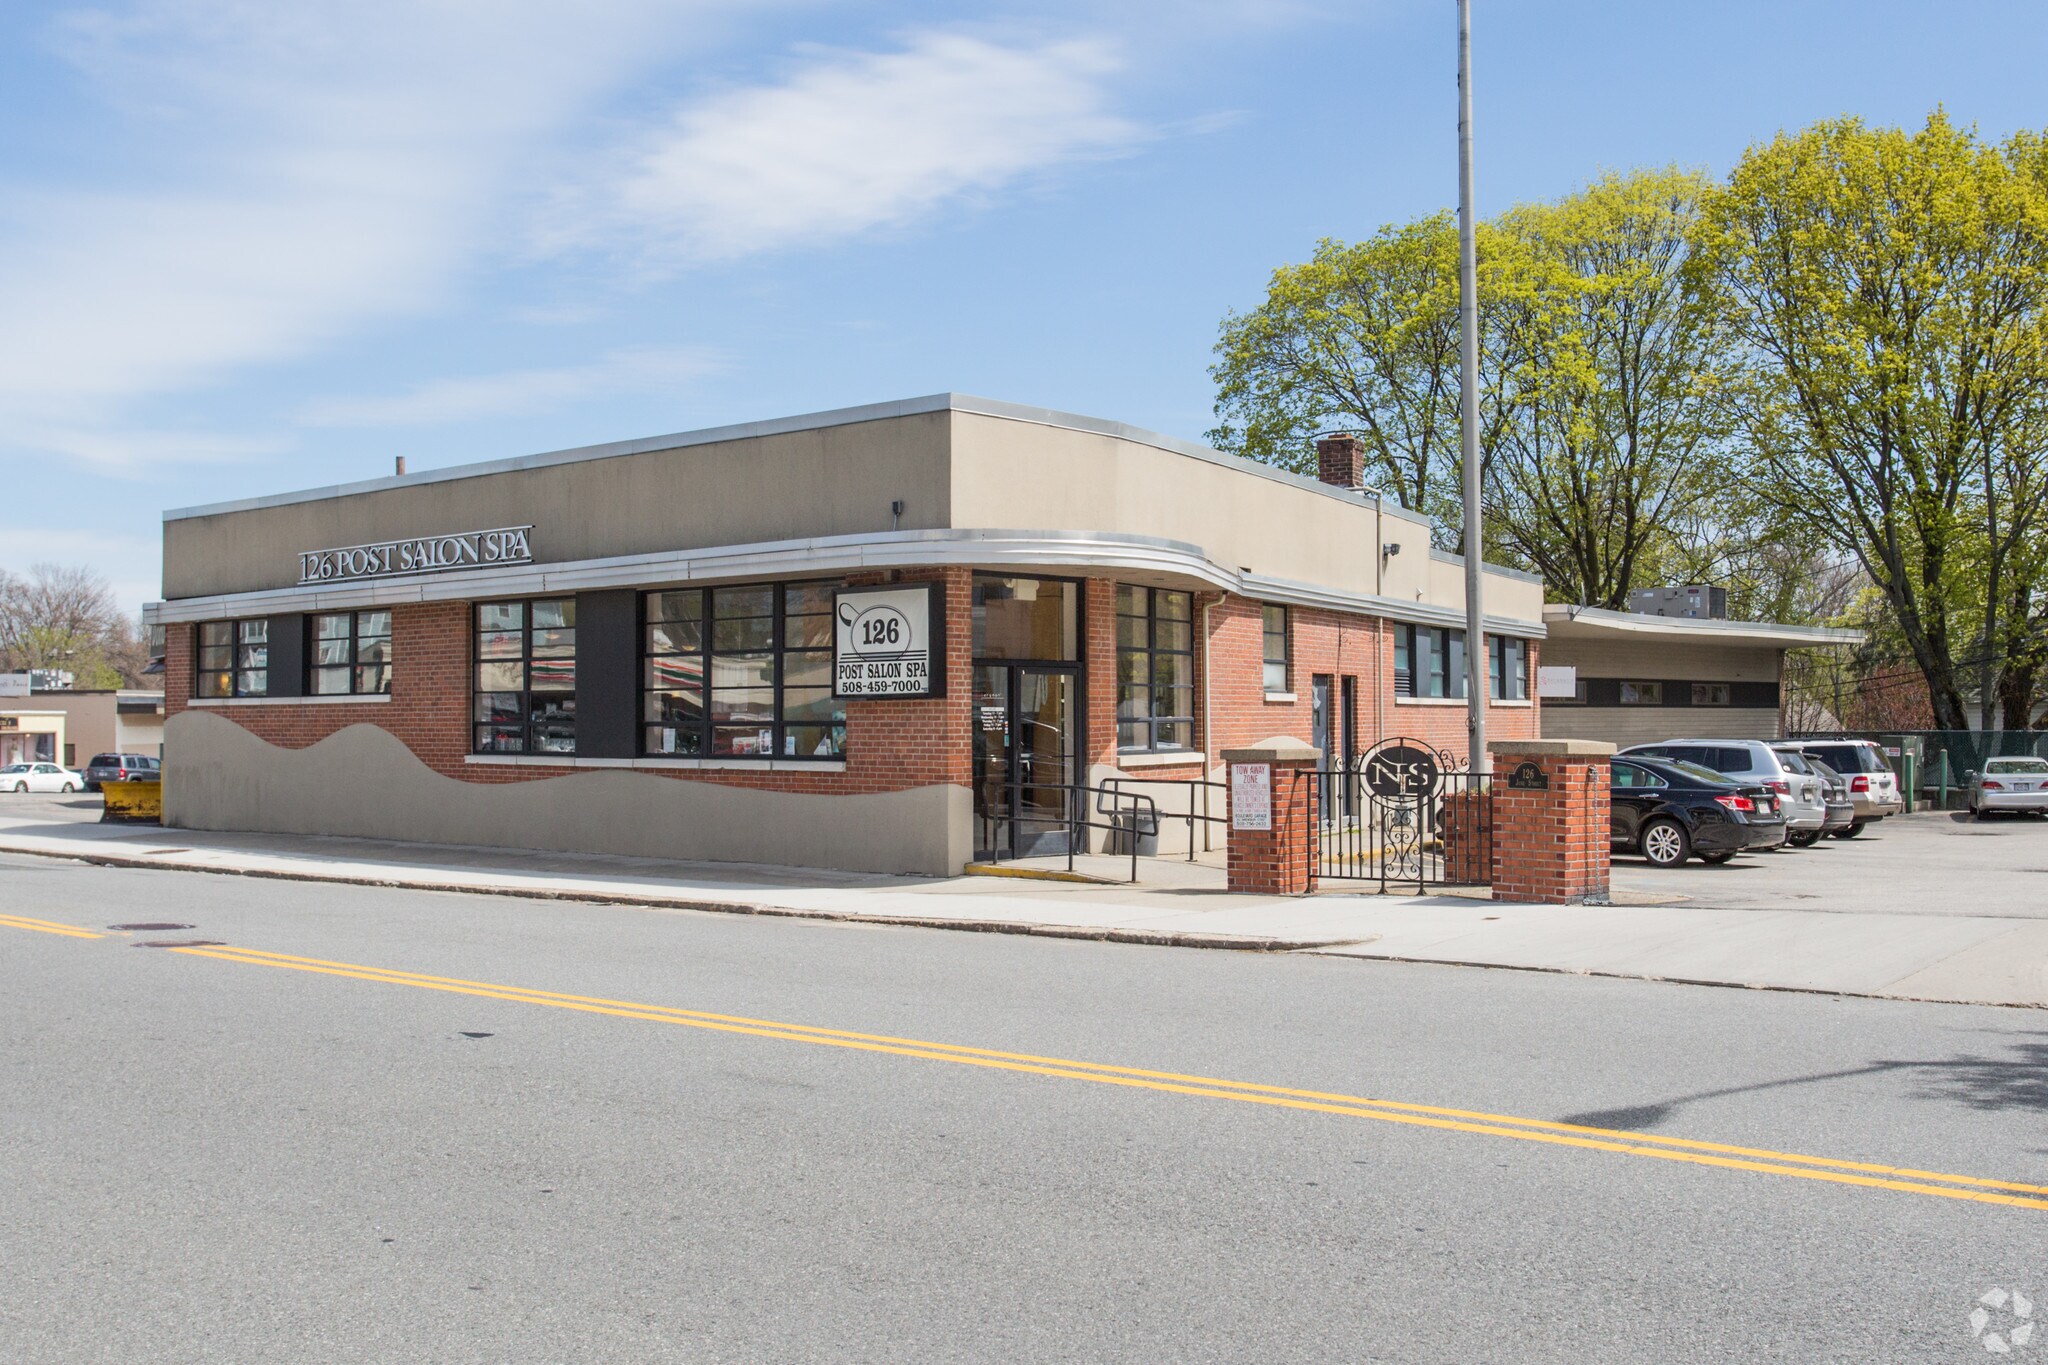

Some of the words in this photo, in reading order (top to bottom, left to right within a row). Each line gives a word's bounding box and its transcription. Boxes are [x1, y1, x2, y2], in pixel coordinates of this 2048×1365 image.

[300, 554, 332, 581] 126
[335, 545, 398, 577] POST
[401, 535, 481, 571] SALON
[485, 530, 532, 561] SPA
[863, 618, 899, 645] 126
[839, 664, 863, 679] POST
[868, 662, 901, 679] SALON
[906, 662, 927, 678] SPA
[842, 680, 921, 693] 508-459-7000
[1236, 766, 1248, 775] TOW
[1250, 766, 1265, 775] AWAY
[1522, 768, 1535, 779] 126
[1243, 775, 1258, 784] ZONE
